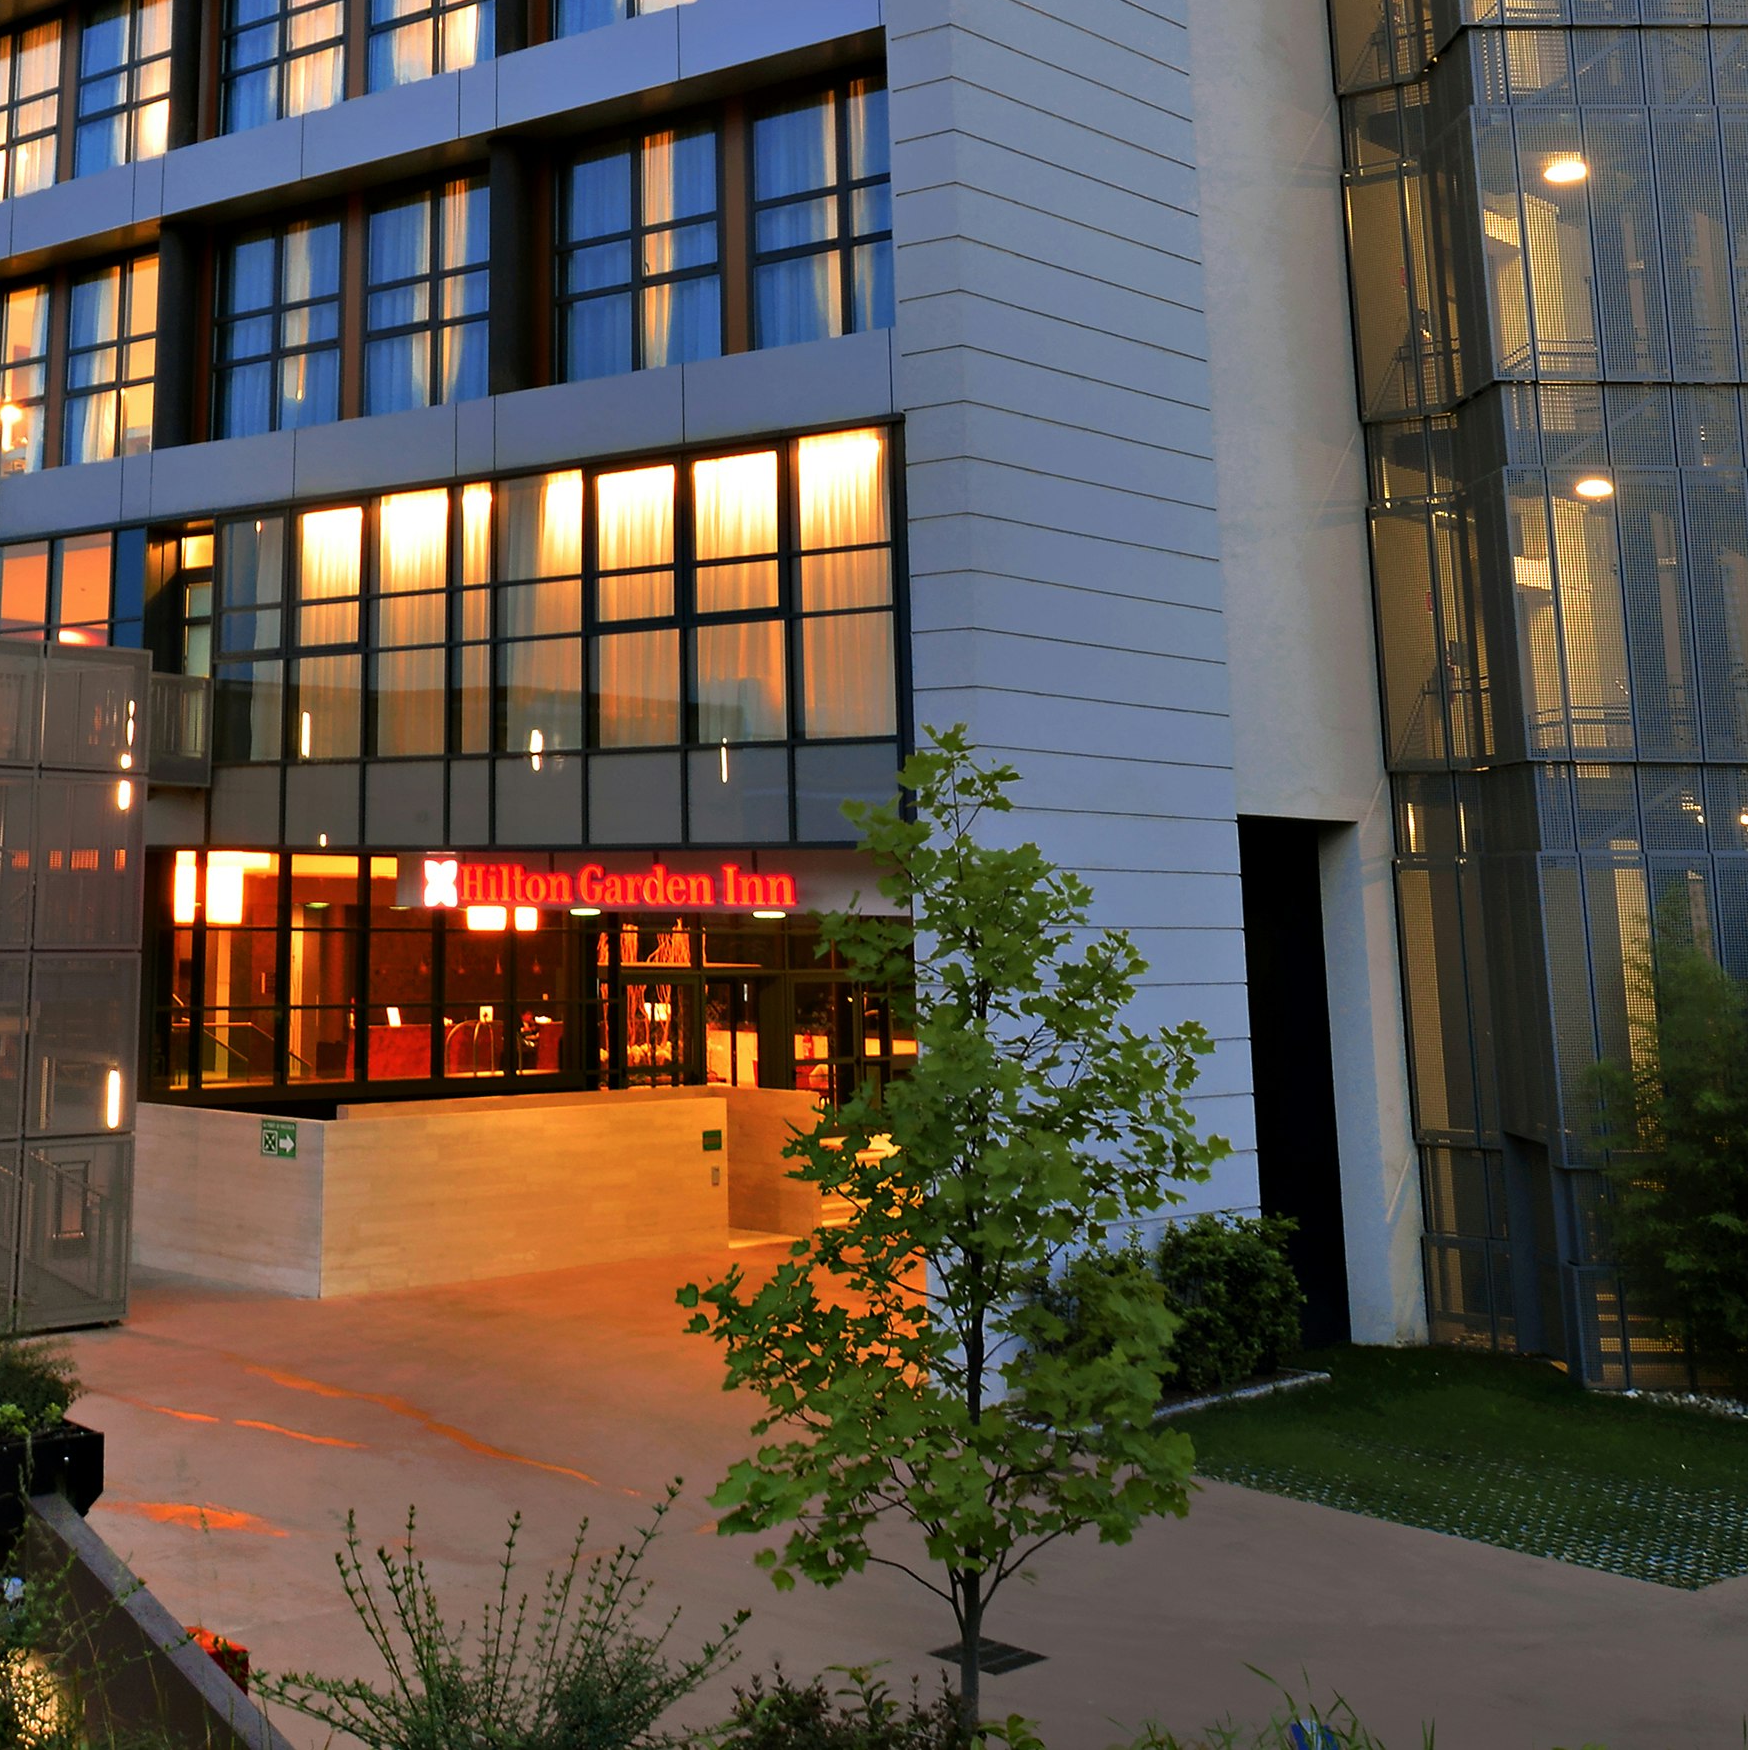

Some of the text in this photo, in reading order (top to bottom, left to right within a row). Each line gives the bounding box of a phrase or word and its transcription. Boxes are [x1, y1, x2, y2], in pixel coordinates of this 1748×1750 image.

[460, 862, 796, 906] Hilton Garden Inn
